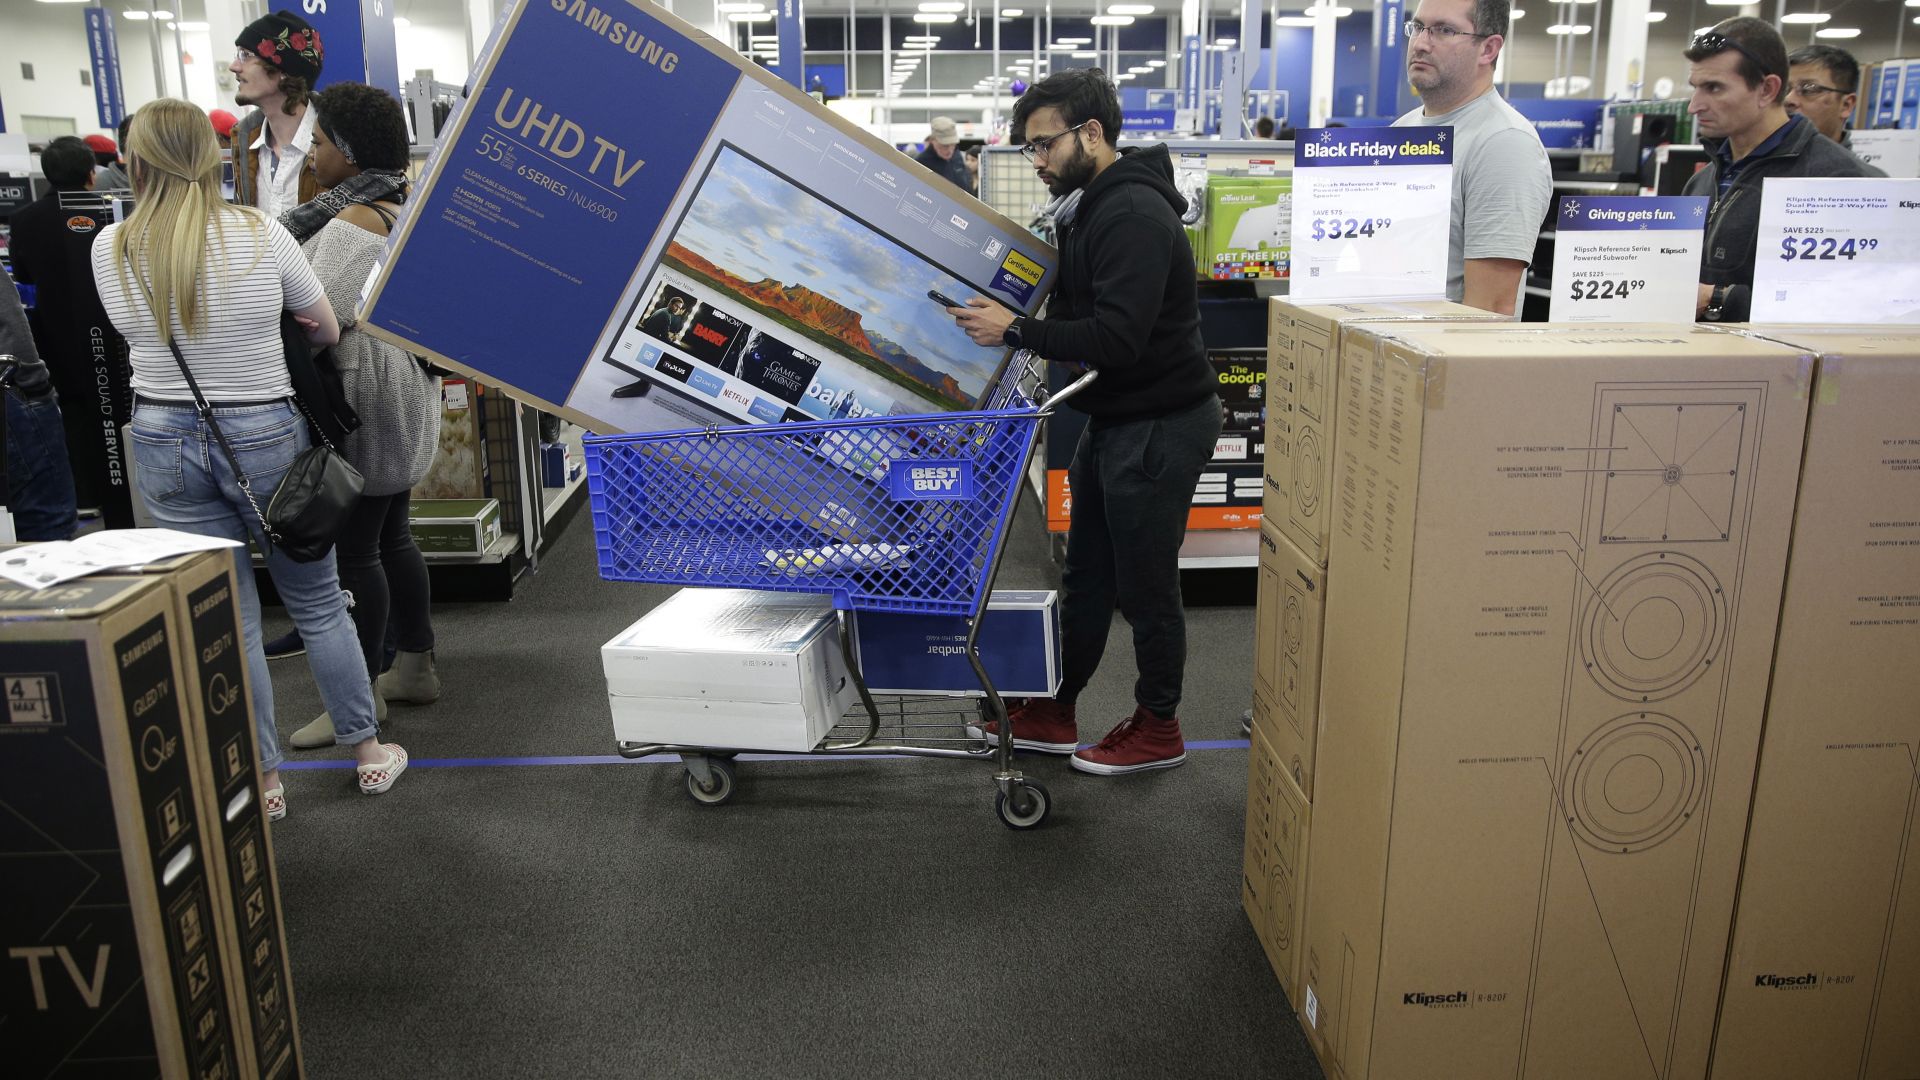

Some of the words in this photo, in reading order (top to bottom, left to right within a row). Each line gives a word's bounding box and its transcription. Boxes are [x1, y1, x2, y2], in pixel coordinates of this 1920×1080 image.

[493, 87, 586, 159] UHD
[588, 135, 646, 188] TV
[1304, 142, 1348, 158] Black
[1350, 141, 1398, 159] Friday
[1399, 140, 1445, 156] deals.
[517, 165, 526, 177] 6
[526, 168, 569, 197] SERIES
[572, 191, 618, 223] NU6900
[1407, 183, 1436, 191] Klipsch
[1588, 208, 1626, 222] Giving
[1627, 210, 1653, 223] gets
[1653, 209, 1676, 220] fun.
[1216, 253, 1238, 262] GET
[1241, 251, 1268, 261] FREE
[1574, 246, 1598, 254] Klipsch
[1660, 247, 1688, 255] Klipsch
[1006, 256, 1030, 274] Certified
[1027, 269, 1040, 280] UHD
[661, 272, 684, 287] Popular
[692, 322, 730, 348] BARRY
[90, 326, 106, 365] GEEK
[770, 361, 795, 379] GAME
[1218, 372, 1255, 384] Good
[1230, 365, 1249, 374] The
[762, 367, 800, 393] THRONES
[95, 367, 113, 415] SQUAD
[722, 387, 750, 407] NETFLIX
[103, 420, 123, 486] SERVICES
[912, 467, 960, 479] BEST
[913, 479, 957, 491] BUY
[193, 586, 229, 618] SAMSUNG
[121, 629, 165, 668] SAMSUNG
[221, 632, 233, 649] TV
[10, 679, 25, 699] 4
[156, 679, 169, 698] TV
[13, 702, 36, 712] MAX
[9, 944, 111, 1010] TV
[1755, 973, 1817, 988] Klipsch
[1403, 990, 1468, 1006] Klipsch
